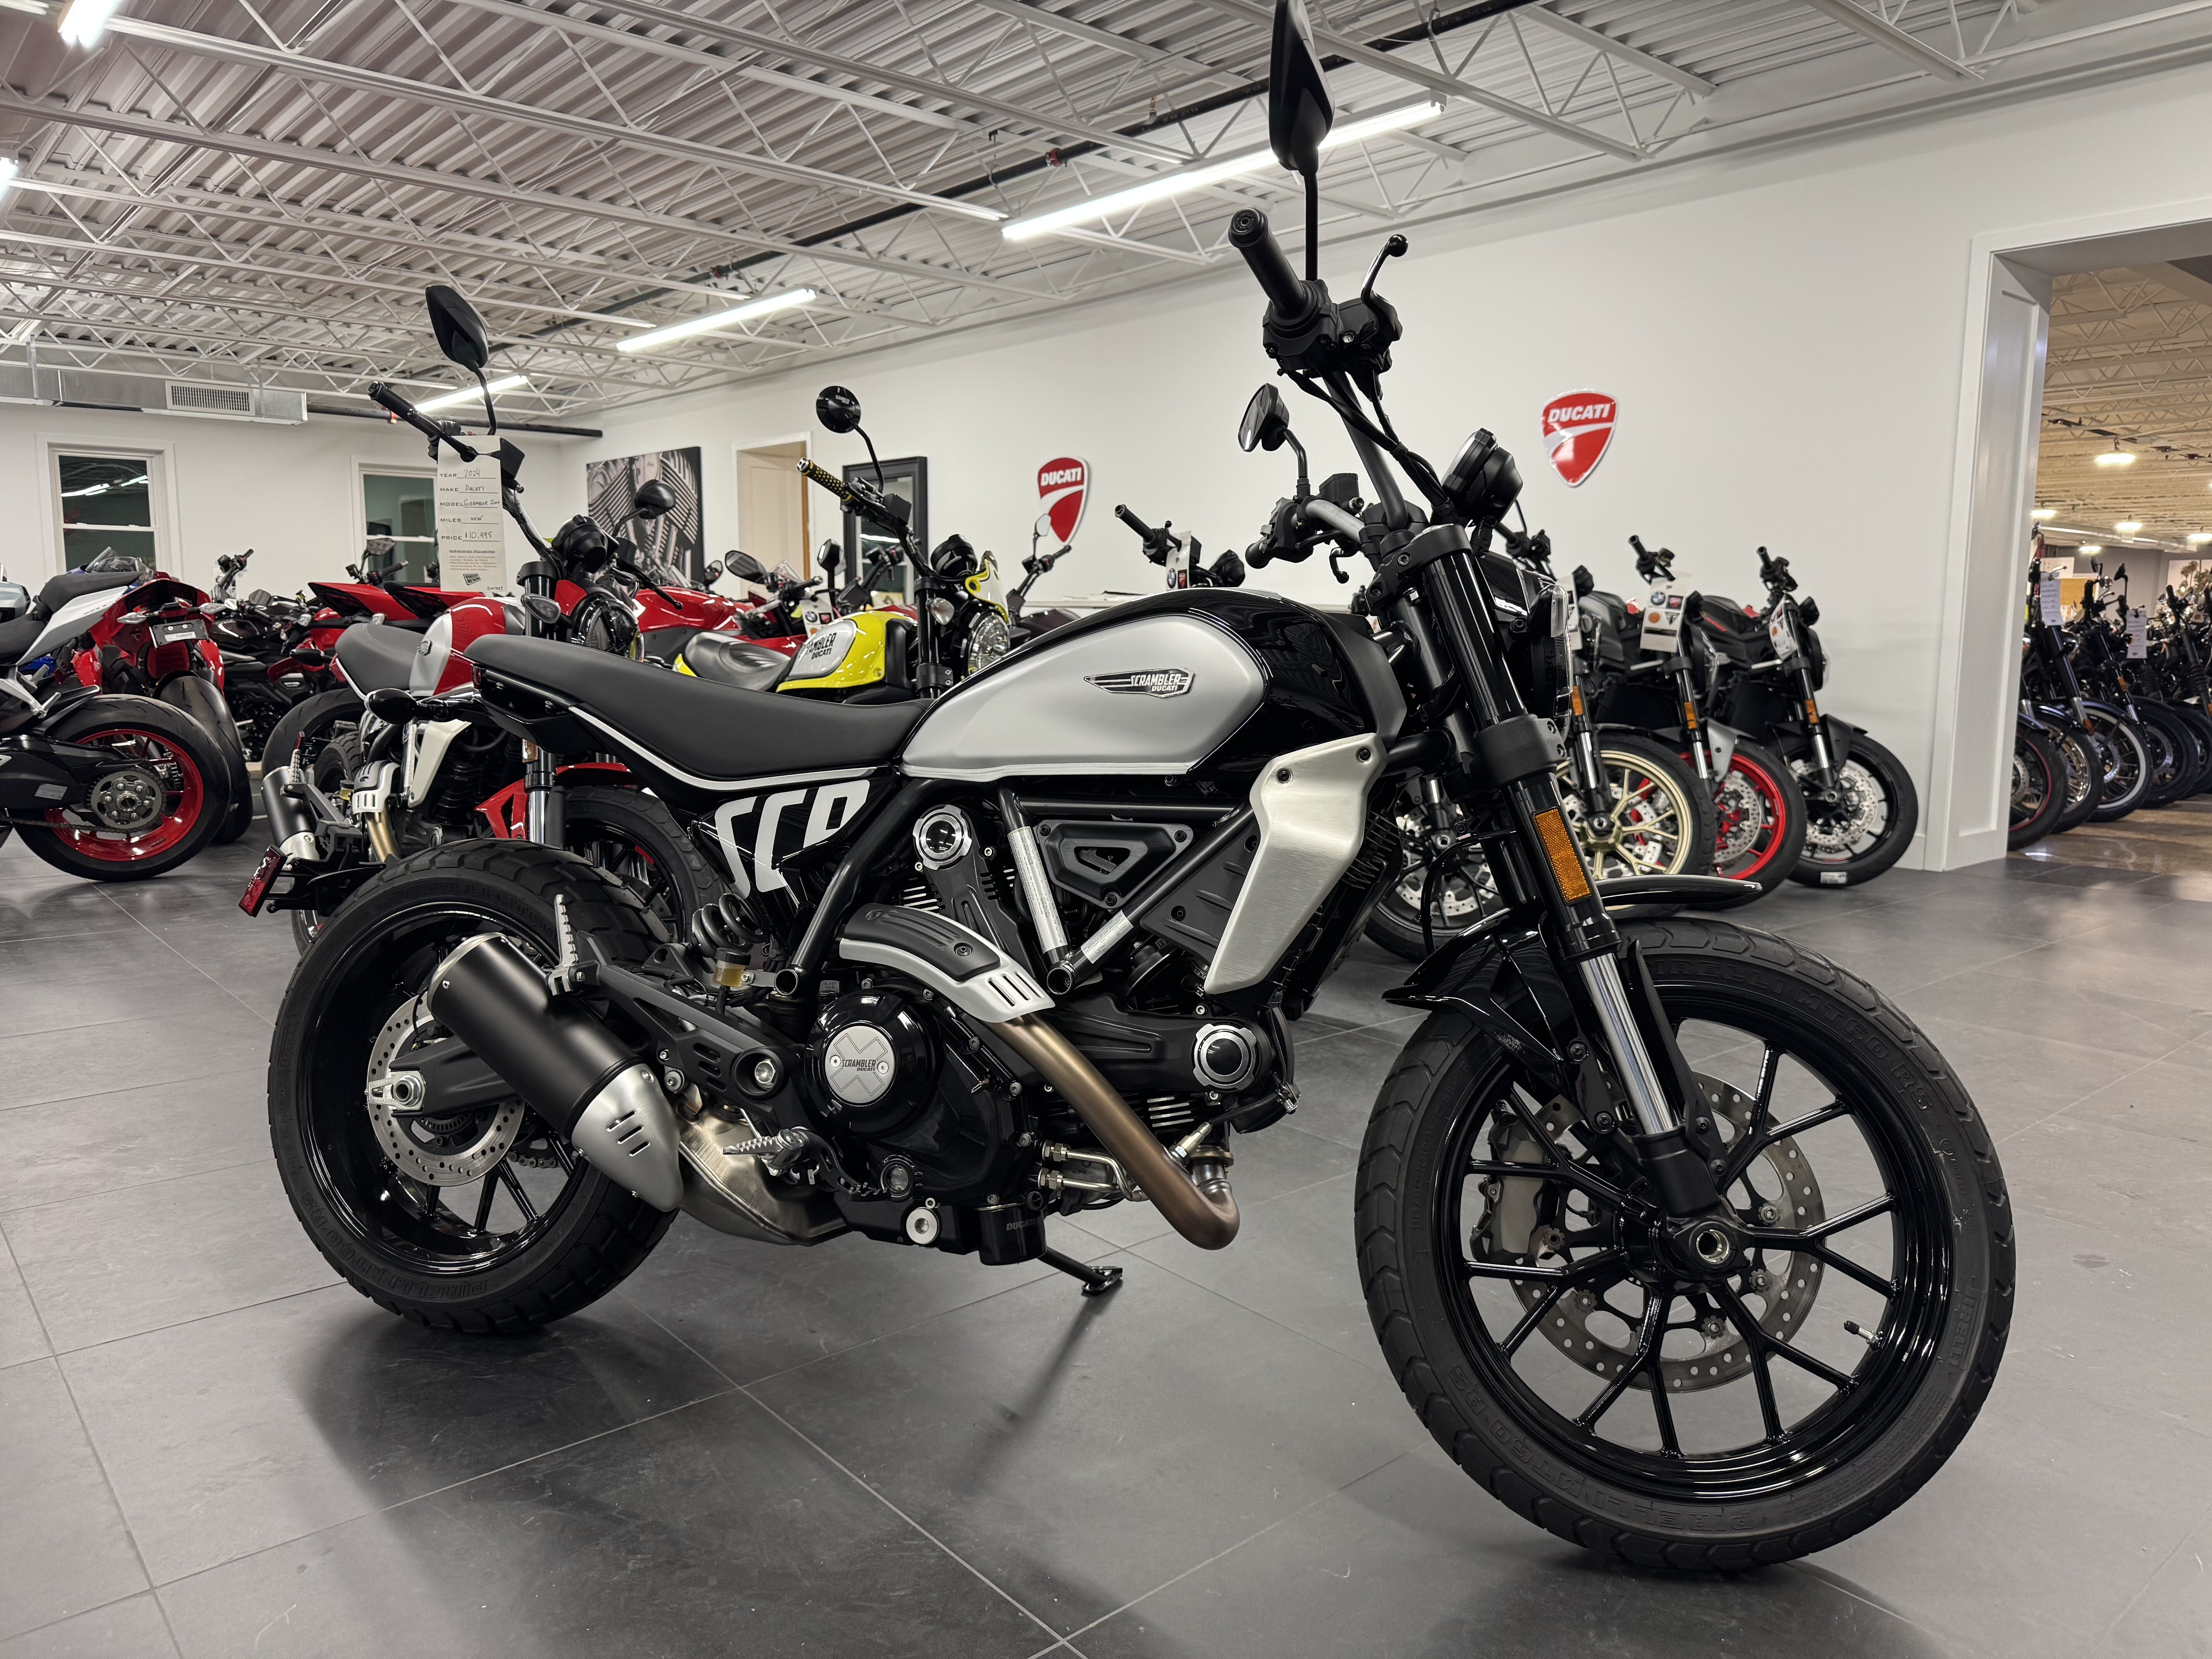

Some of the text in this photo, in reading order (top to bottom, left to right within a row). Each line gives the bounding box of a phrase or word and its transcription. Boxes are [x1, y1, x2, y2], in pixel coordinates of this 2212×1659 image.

[1547, 404, 1611, 423] DUCATI
[464, 467, 480, 477] 2024
[1040, 467, 1082, 487] DUCATI
[811, 648, 832, 659] DUCATI
[1130, 673, 1182, 686] SCRAMBLER
[1645, 958, 1785, 995] IRELLI
[841, 1059, 876, 1067] SCRAMBLER
[1591, 1490, 1754, 1530] PIRELLI
